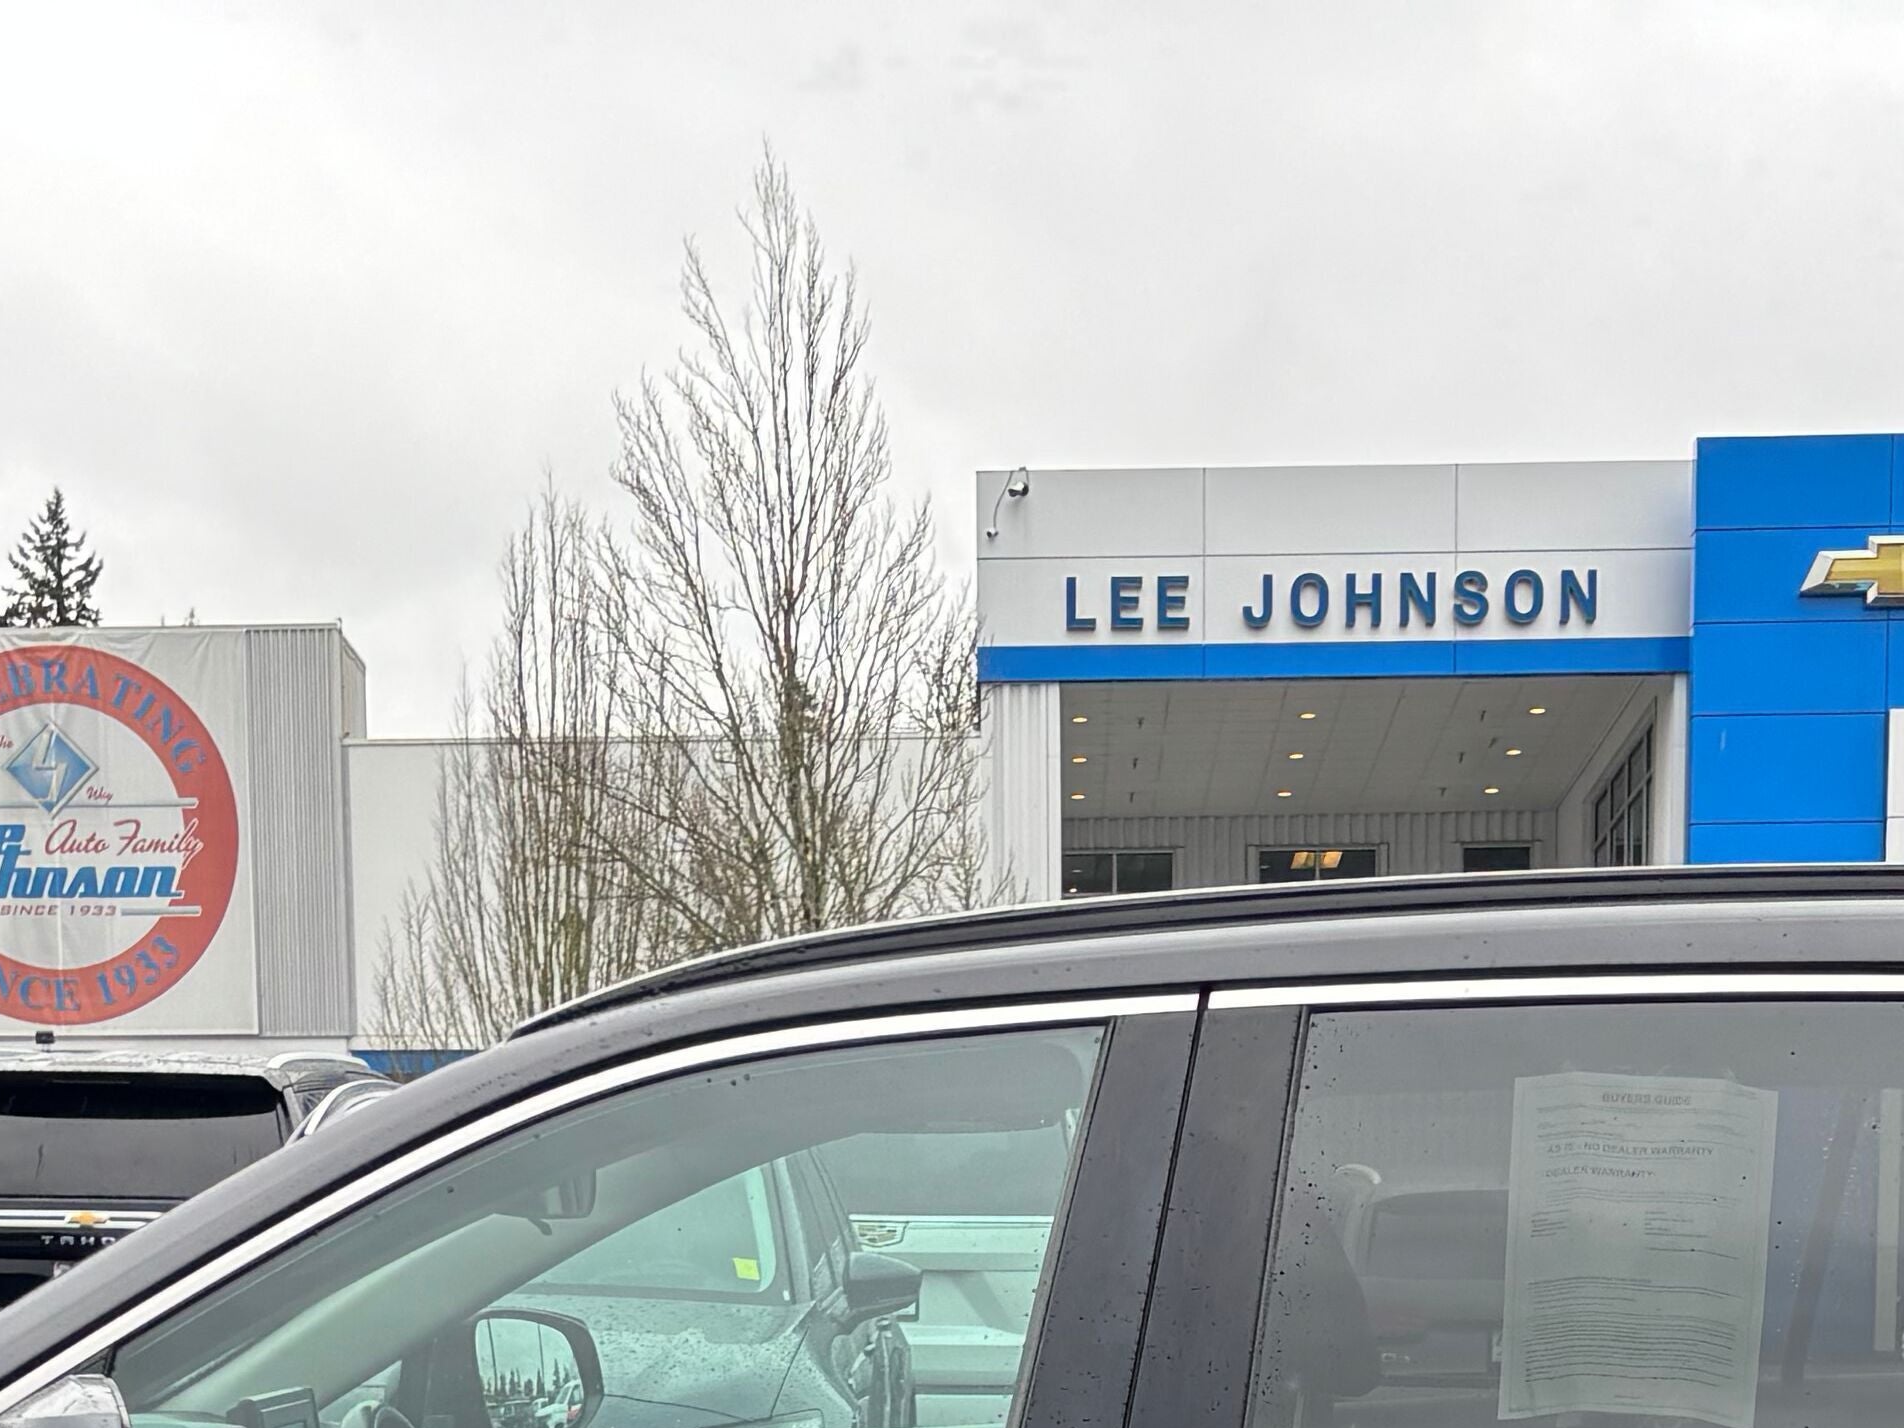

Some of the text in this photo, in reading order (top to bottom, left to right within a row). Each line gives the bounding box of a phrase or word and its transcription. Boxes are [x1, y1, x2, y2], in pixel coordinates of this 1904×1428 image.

[1064, 568, 1598, 632] LEE JOHNSON
[86, 786, 114, 805] Way
[45, 818, 110, 857] Auto
[112, 818, 204, 866] Family
[0, 904, 117, 917] SINCE 1933
[96, 934, 181, 1006] 1933
